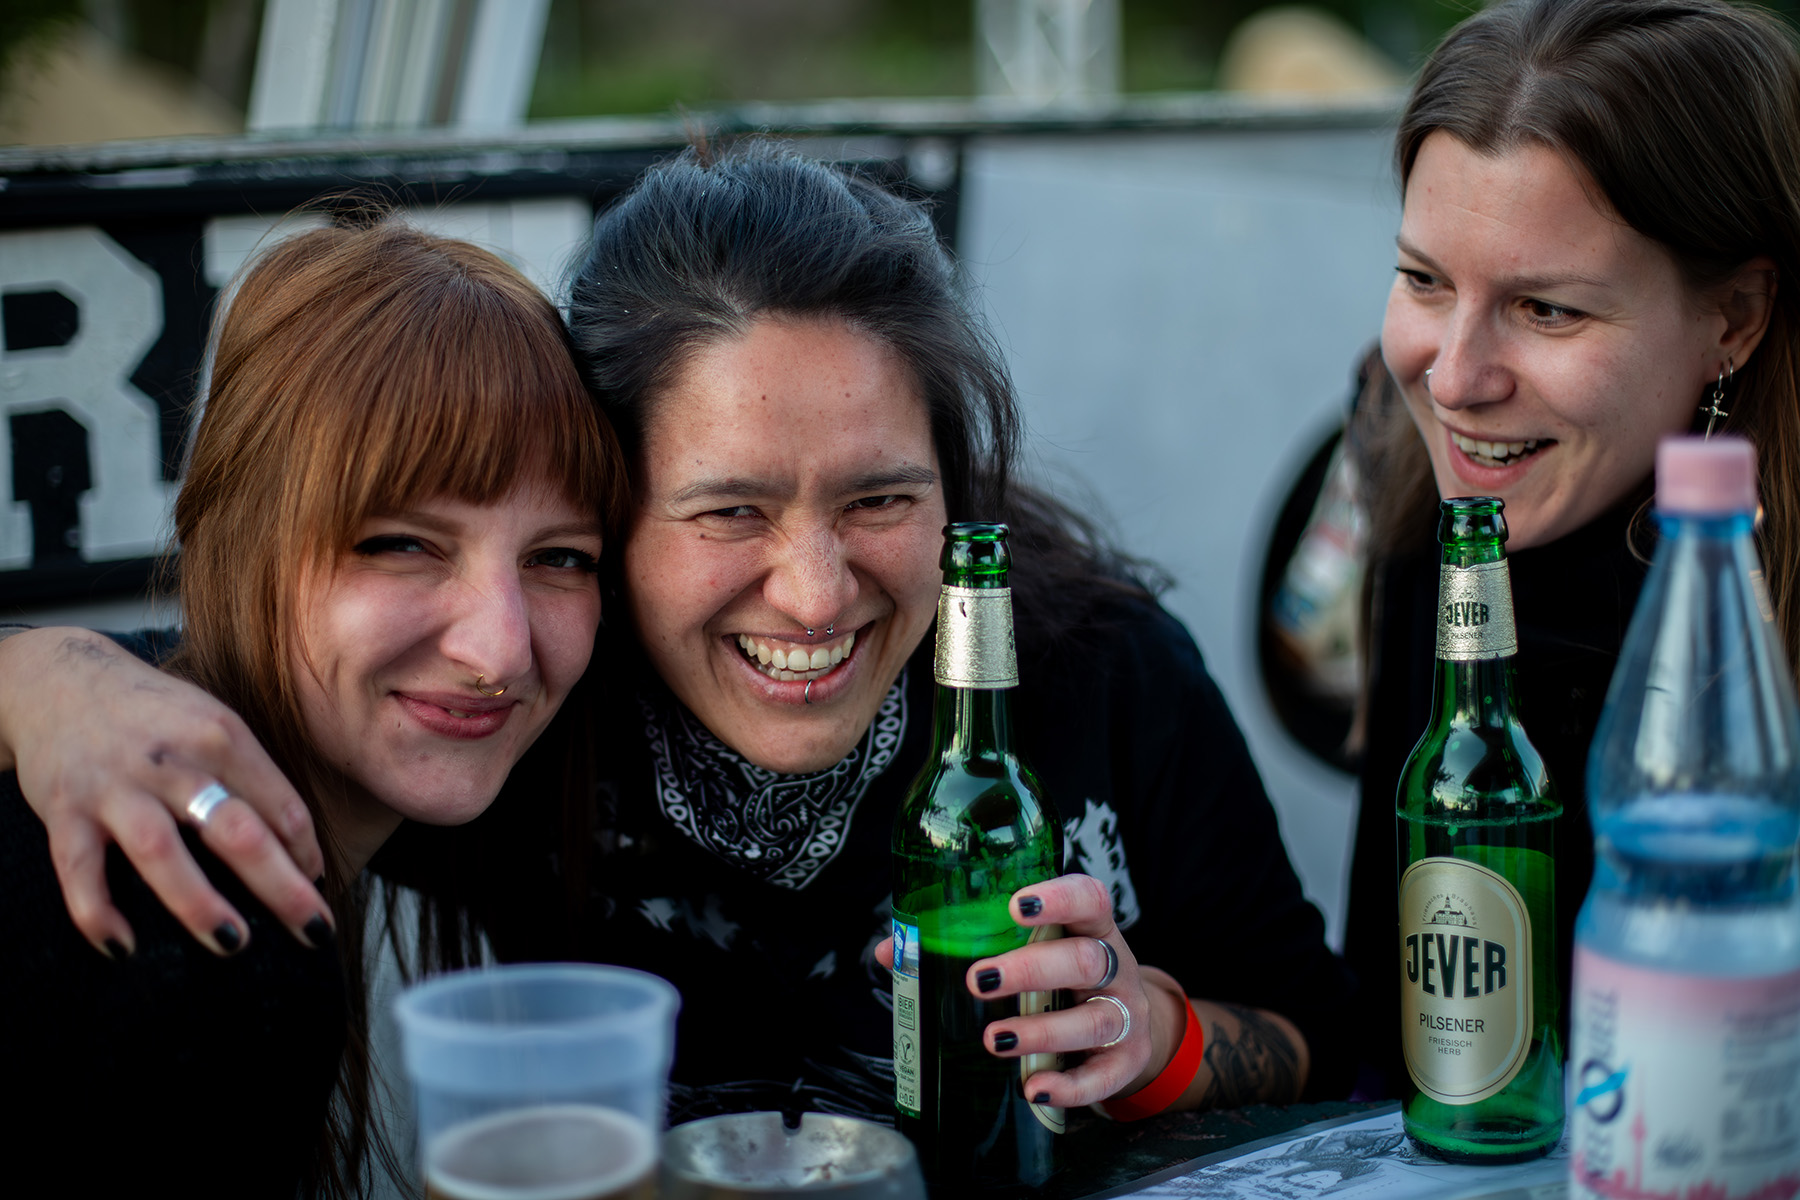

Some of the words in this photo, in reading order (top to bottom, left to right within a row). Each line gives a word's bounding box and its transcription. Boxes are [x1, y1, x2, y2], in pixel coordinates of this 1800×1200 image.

[1445, 602, 1489, 627] JEVER
[1406, 932, 1507, 999] JEVER
[1419, 1012, 1485, 1033] PILSENER
[1428, 1036, 1473, 1048] FRIESISCH
[1437, 1046, 1462, 1056] HERB
